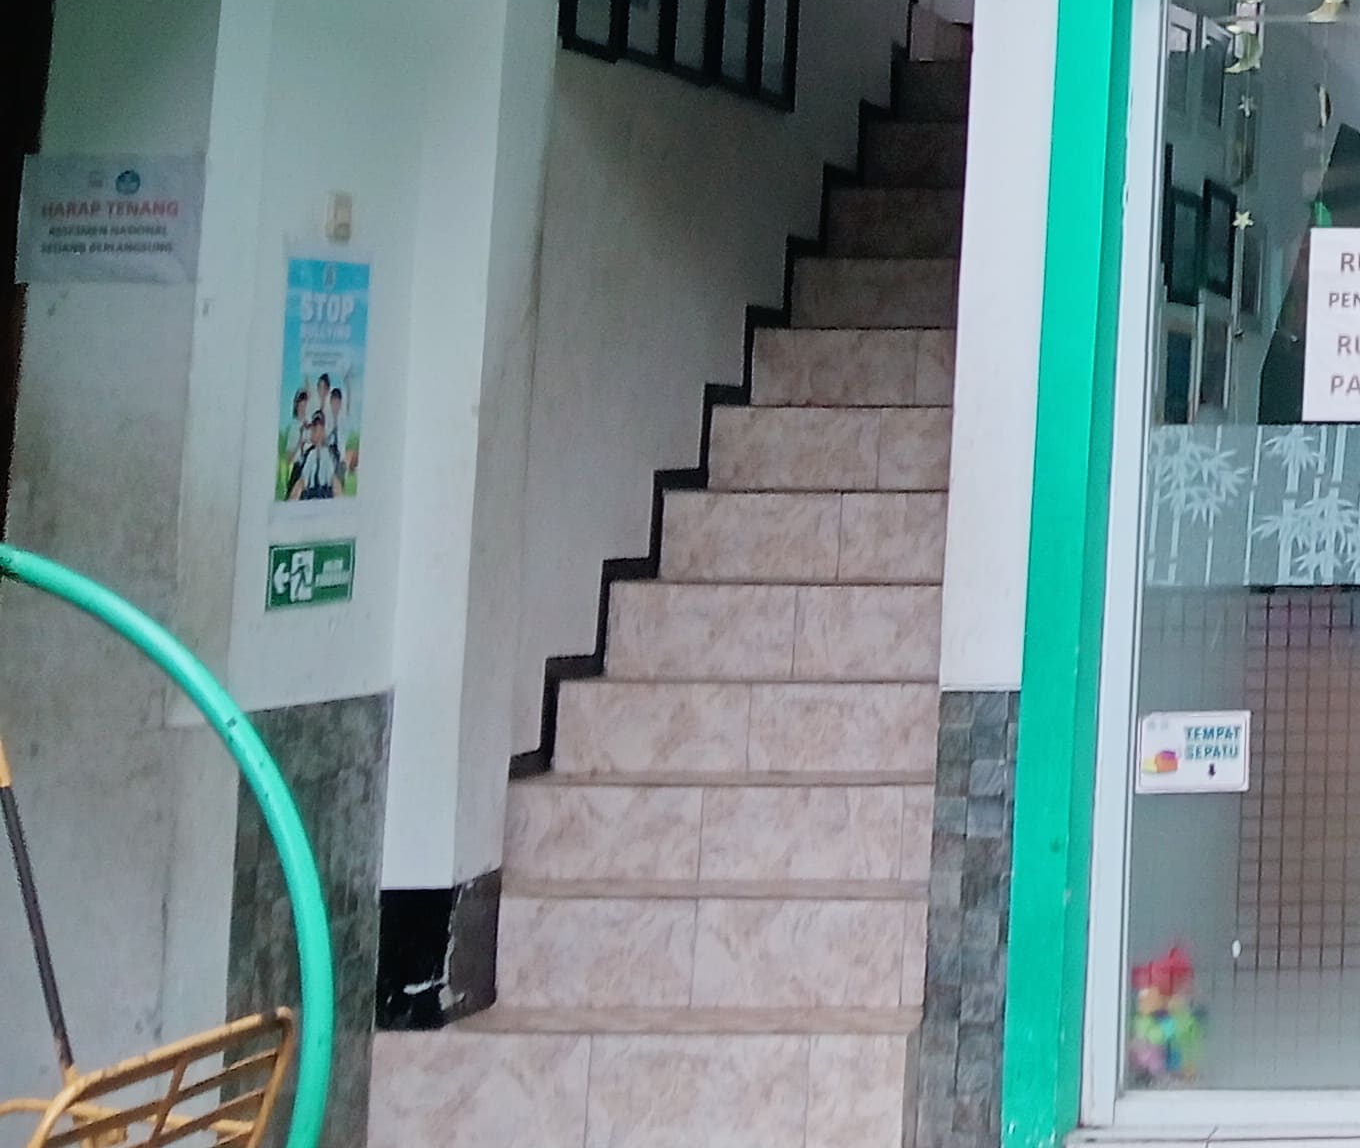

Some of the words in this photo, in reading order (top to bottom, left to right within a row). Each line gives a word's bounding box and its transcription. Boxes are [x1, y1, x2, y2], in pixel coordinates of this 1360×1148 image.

[41, 201, 101, 219] HARAP
[108, 200, 179, 219] TENANG
[301, 293, 355, 325] STOP
[1184, 725, 1241, 740] TEMPAT
